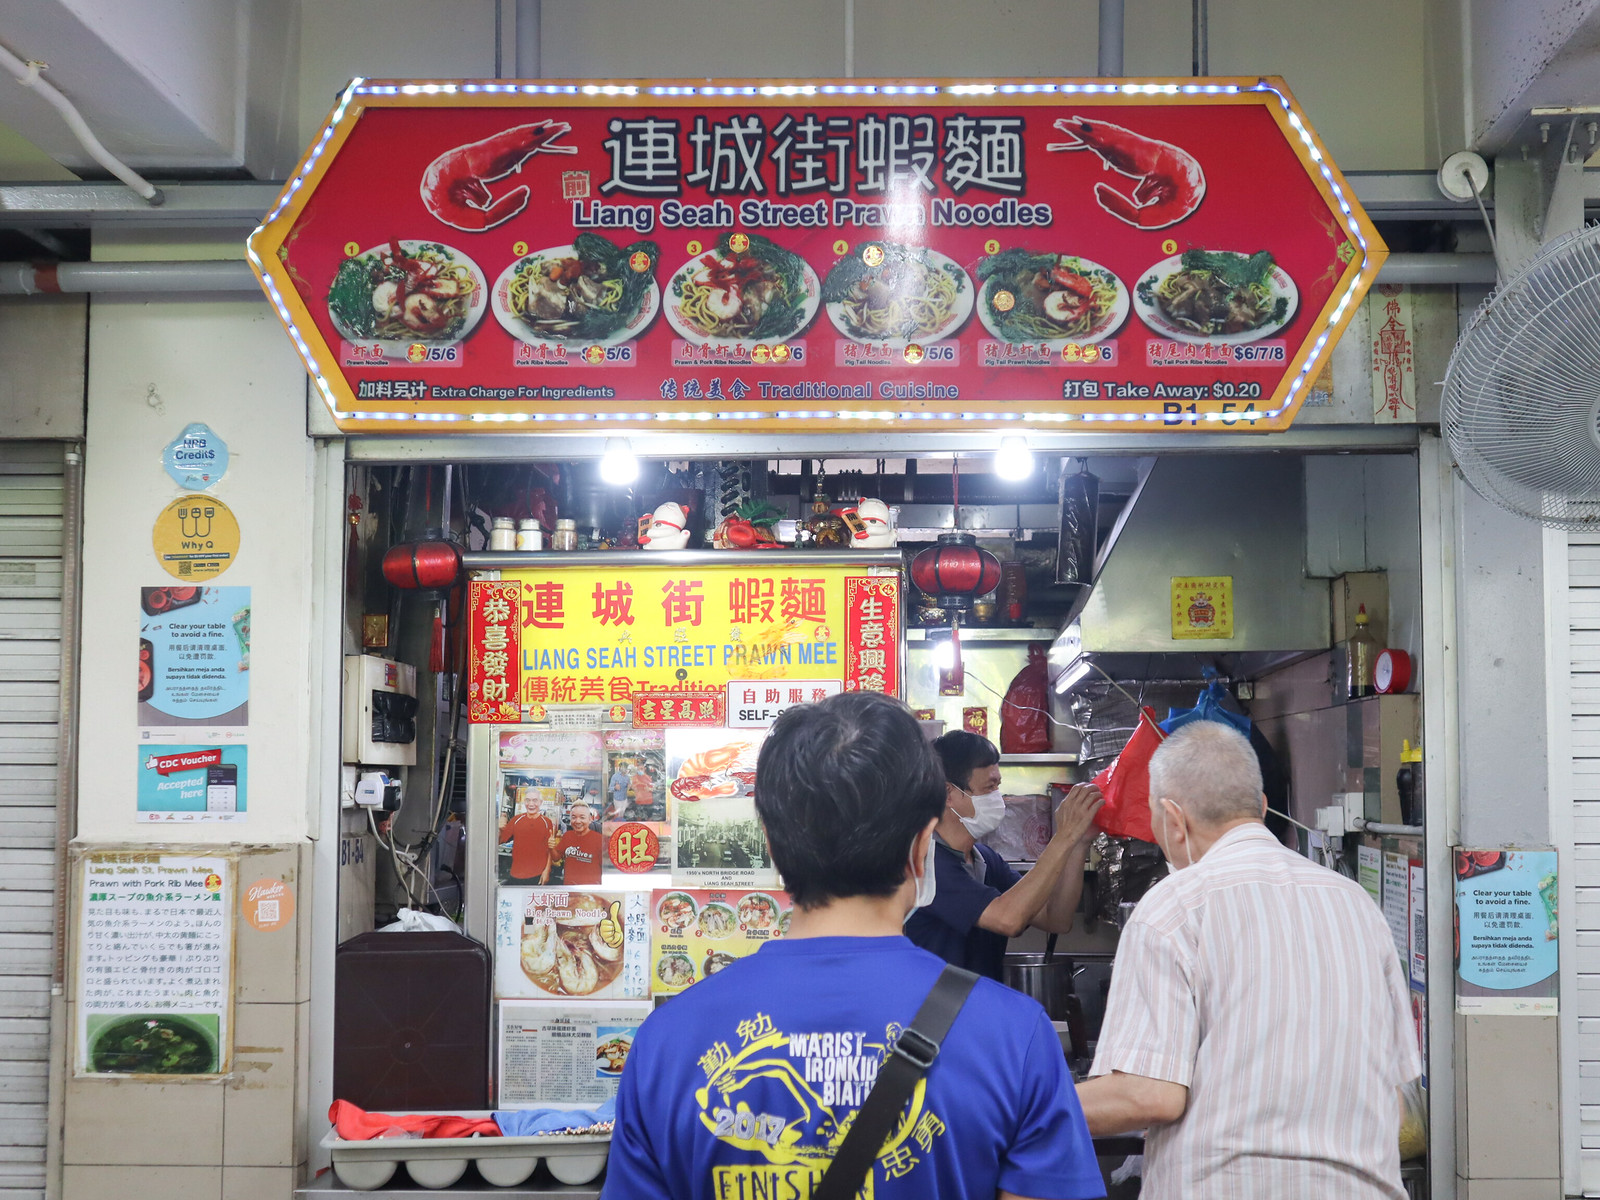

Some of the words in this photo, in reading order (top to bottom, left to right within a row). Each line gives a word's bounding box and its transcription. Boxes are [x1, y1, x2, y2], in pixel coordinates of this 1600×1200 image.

[600, 115, 1023, 193] 連城街蝦麵
[573, 201, 654, 231] Liang
[661, 200, 733, 227] Seah
[741, 200, 827, 227] Street
[932, 199, 1052, 226] Noodles
[352, 343, 384, 359] 虾面
[1234, 347, 1284, 361] $6/7/8
[358, 380, 427, 399] 加料另计
[432, 386, 467, 398] Extra
[468, 386, 515, 400] Charge
[518, 386, 539, 398] For
[541, 386, 614, 400] Ingredients
[660, 378, 750, 399] 传统美食
[758, 381, 872, 398] Traditional
[879, 381, 959, 398] Cuisine
[1064, 380, 1099, 398] 打包
[1104, 382, 1151, 398] Take
[1153, 382, 1209, 401] Away:
[1212, 381, 1262, 399] $0.20
[175, 449, 215, 460] Credit$
[522, 577, 826, 629] 連城街蝦麵
[481, 598, 511, 702] 恭喜發財
[857, 596, 887, 696] 生意興隆
[523, 647, 580, 671] LIANG
[586, 646, 637, 669] SEAH
[643, 645, 717, 668] STREET
[723, 643, 791, 666] PRAWN
[798, 642, 838, 665] MEE
[522, 676, 633, 702] 傳統美食
[743, 688, 827, 705] 自助服務
[641, 700, 716, 721] 吉星高照
[738, 709, 786, 723] SELF-S
[159, 758, 179, 769] CDC
[180, 754, 217, 766] Voucher
[157, 776, 204, 791] Accepted
[180, 788, 204, 799] here
[617, 831, 654, 867] 旺
[89, 866, 114, 875] Liang
[116, 866, 139, 875] Seah
[157, 866, 188, 875] Prawn
[192, 866, 214, 874] Mee
[89, 879, 119, 888] Prawn
[122, 879, 142, 888] with
[144, 879, 165, 888] Pork
[168, 879, 182, 888] Rib
[184, 879, 204, 888] Mee
[527, 893, 569, 907] 大虾面
[1472, 889, 1492, 897] Clear
[1493, 890, 1511, 898] your
[1512, 889, 1532, 897] table
[525, 909, 543, 919] Big
[545, 908, 572, 918] Prawn
[576, 908, 608, 918] Noodle
[789, 1031, 867, 1058] MARIST
[714, 1108, 786, 1145] 2017
